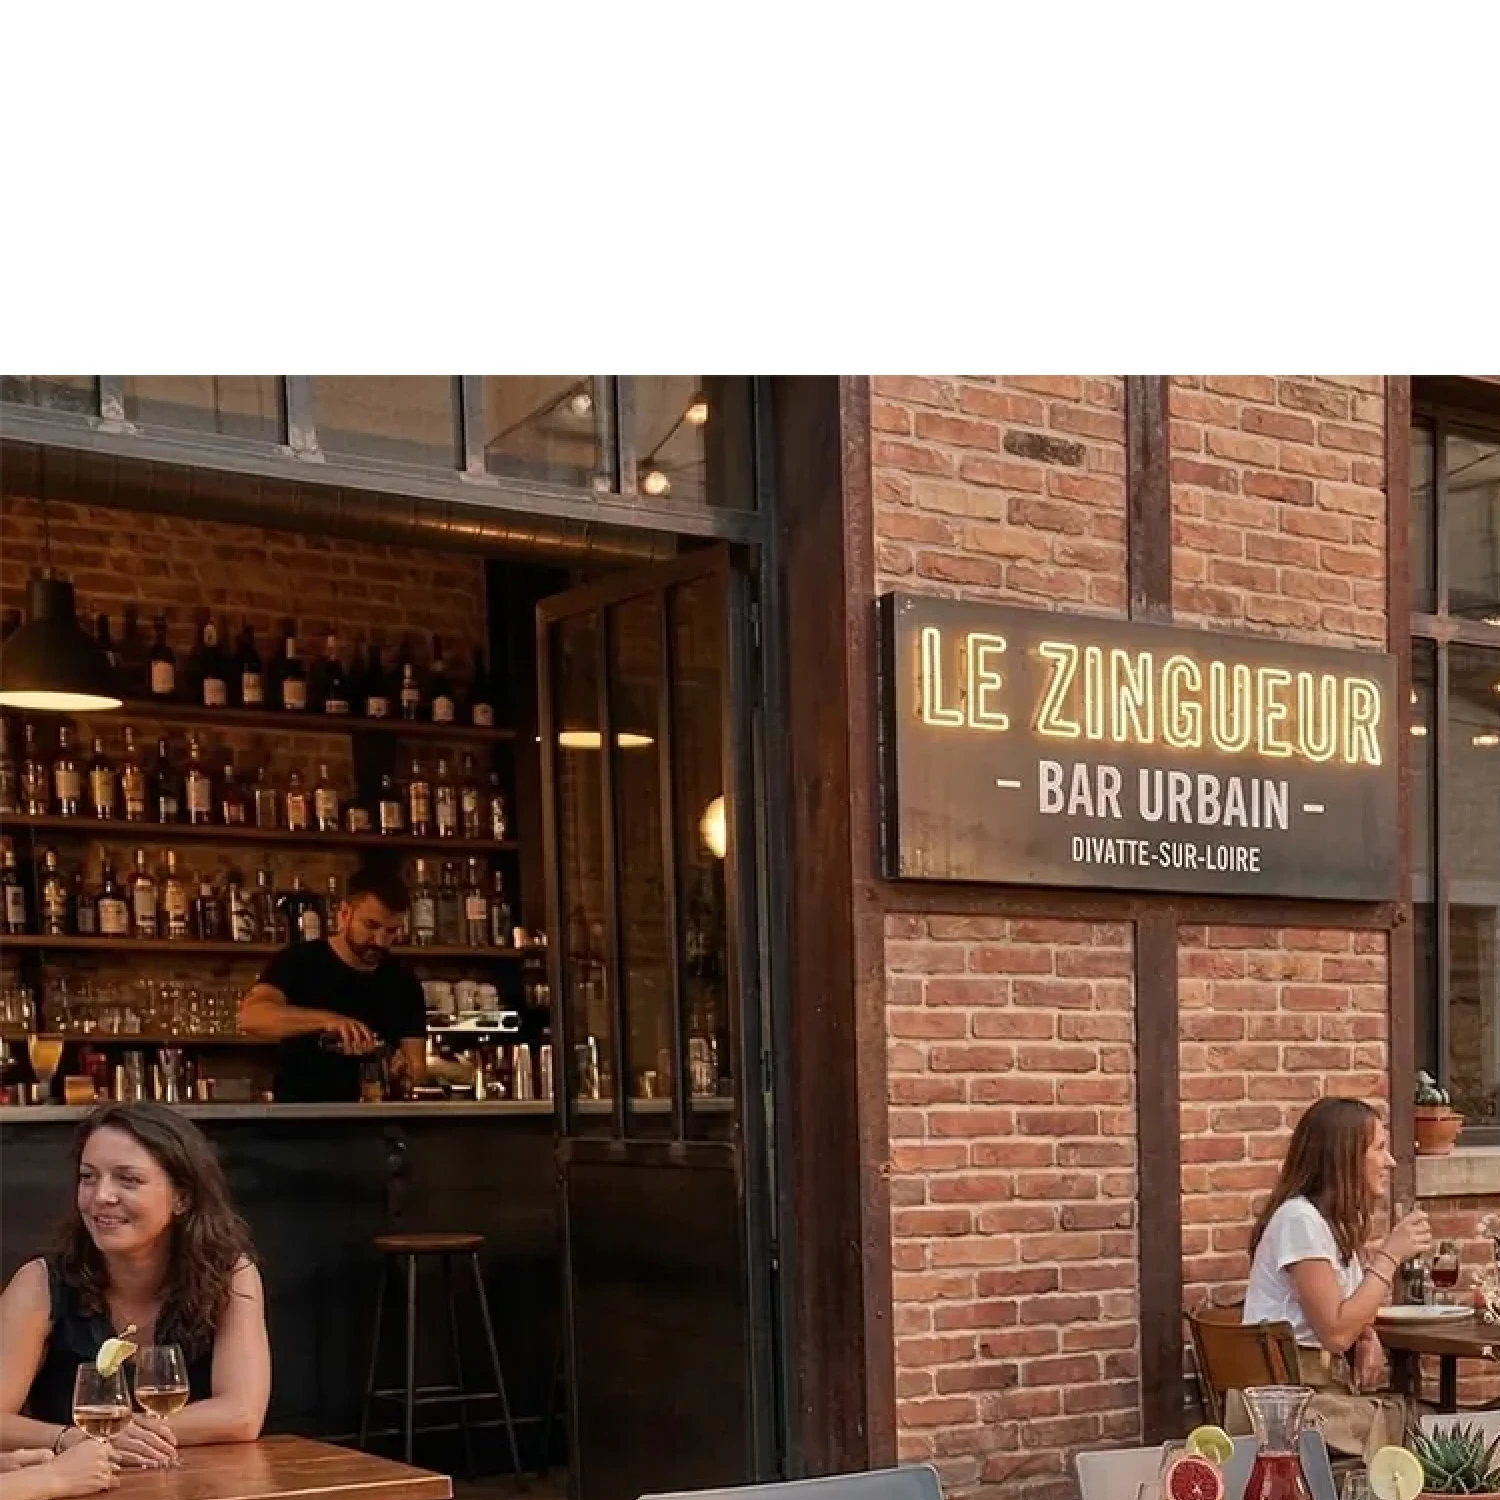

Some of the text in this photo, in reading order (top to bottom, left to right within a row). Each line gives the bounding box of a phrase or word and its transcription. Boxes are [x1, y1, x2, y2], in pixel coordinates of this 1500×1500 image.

[920, 627, 1383, 766] LE ZINGUEUR
[1038, 760, 1290, 830] BAR URBAIN
[1072, 836, 1262, 872] DIVATTE-SUR-LOIRE
